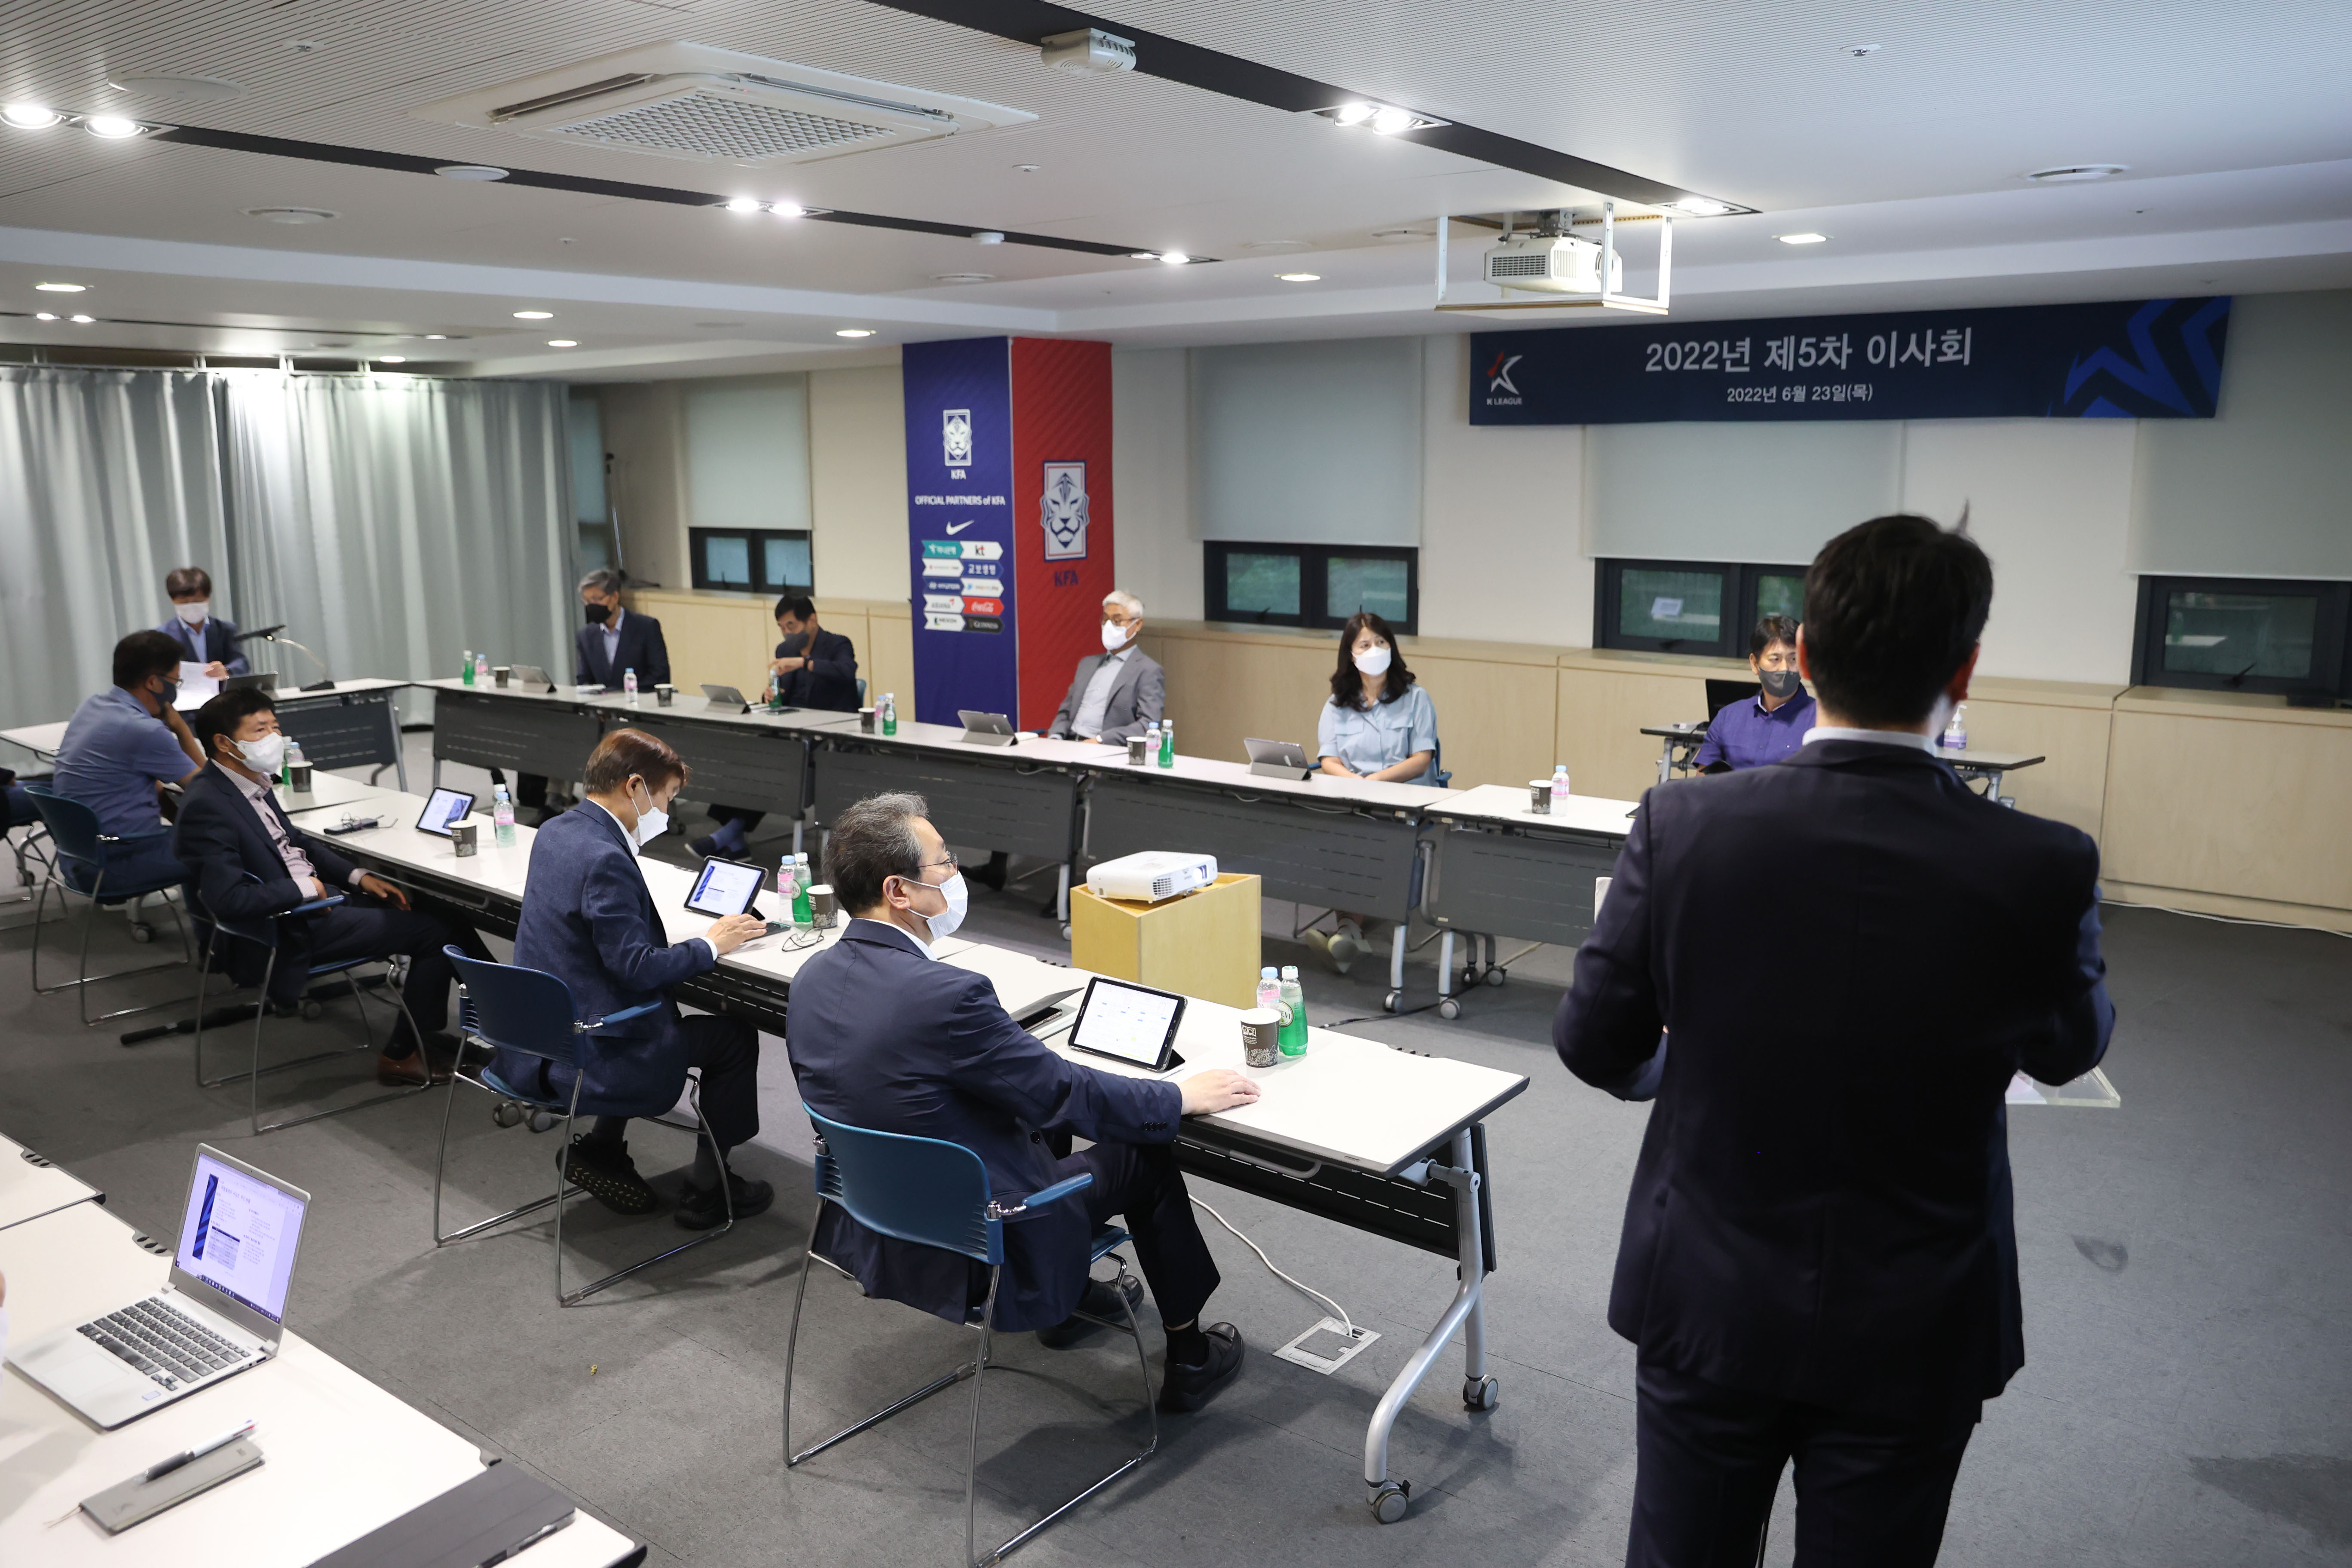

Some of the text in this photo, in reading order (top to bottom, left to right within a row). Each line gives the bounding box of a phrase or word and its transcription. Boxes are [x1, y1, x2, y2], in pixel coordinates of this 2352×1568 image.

[1645, 327, 1971, 372] 2022년 제5차 이사회
[1727, 383, 1873, 403] 2022년 6월 23일(목)
[1494, 397, 1522, 405] LEAGUE
[951, 469, 966, 480] KFA
[915, 495, 945, 505] OFFICIAL
[946, 495, 982, 505] PARTNERS
[991, 496, 1006, 505] KFA
[975, 545, 985, 556] kt
[1054, 570, 1079, 587] KFA
[1280, 1009, 1290, 1019] EVI
